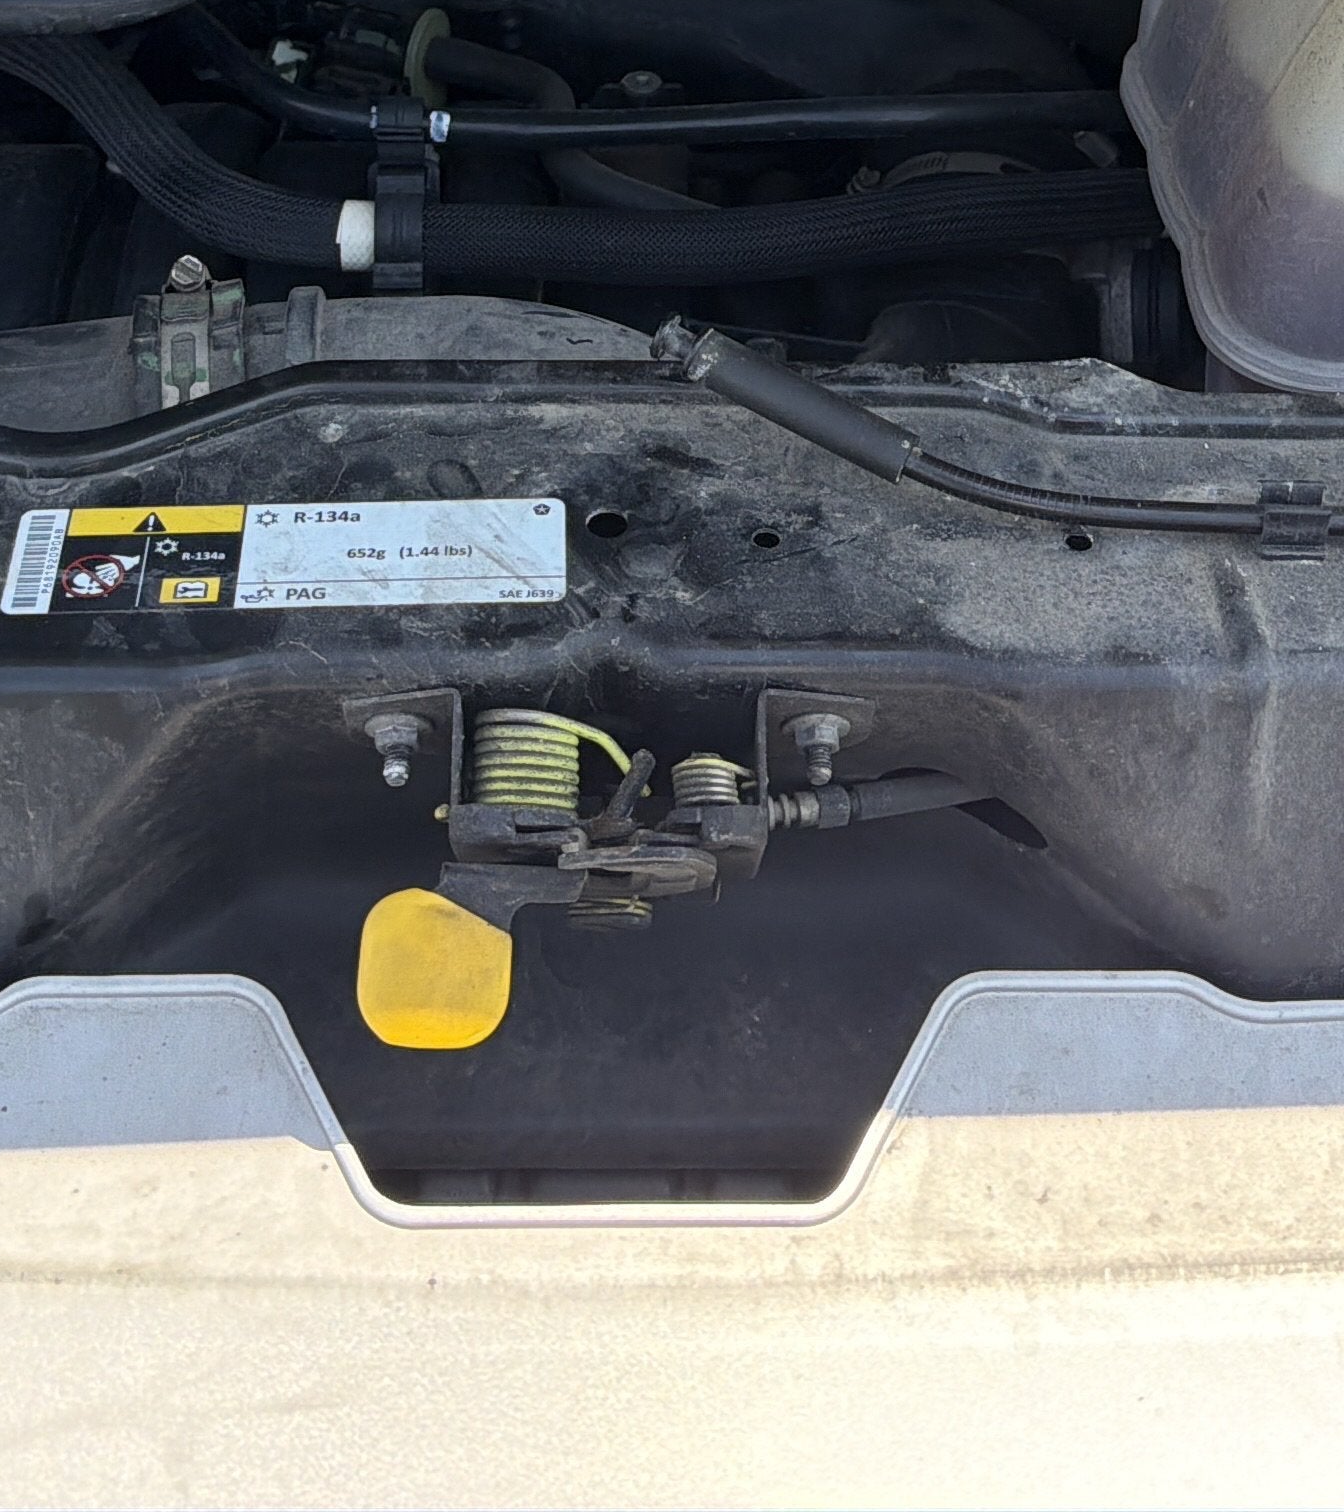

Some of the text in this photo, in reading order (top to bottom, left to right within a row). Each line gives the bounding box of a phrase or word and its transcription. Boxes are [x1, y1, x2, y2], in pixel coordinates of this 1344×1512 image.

[293, 510, 362, 524] R-134a
[181, 550, 227, 562] R-134a
[346, 544, 474, 561] 652g (1.44 lbs)
[285, 587, 327, 601] PAG
[498, 589, 554, 599] SAE J639
